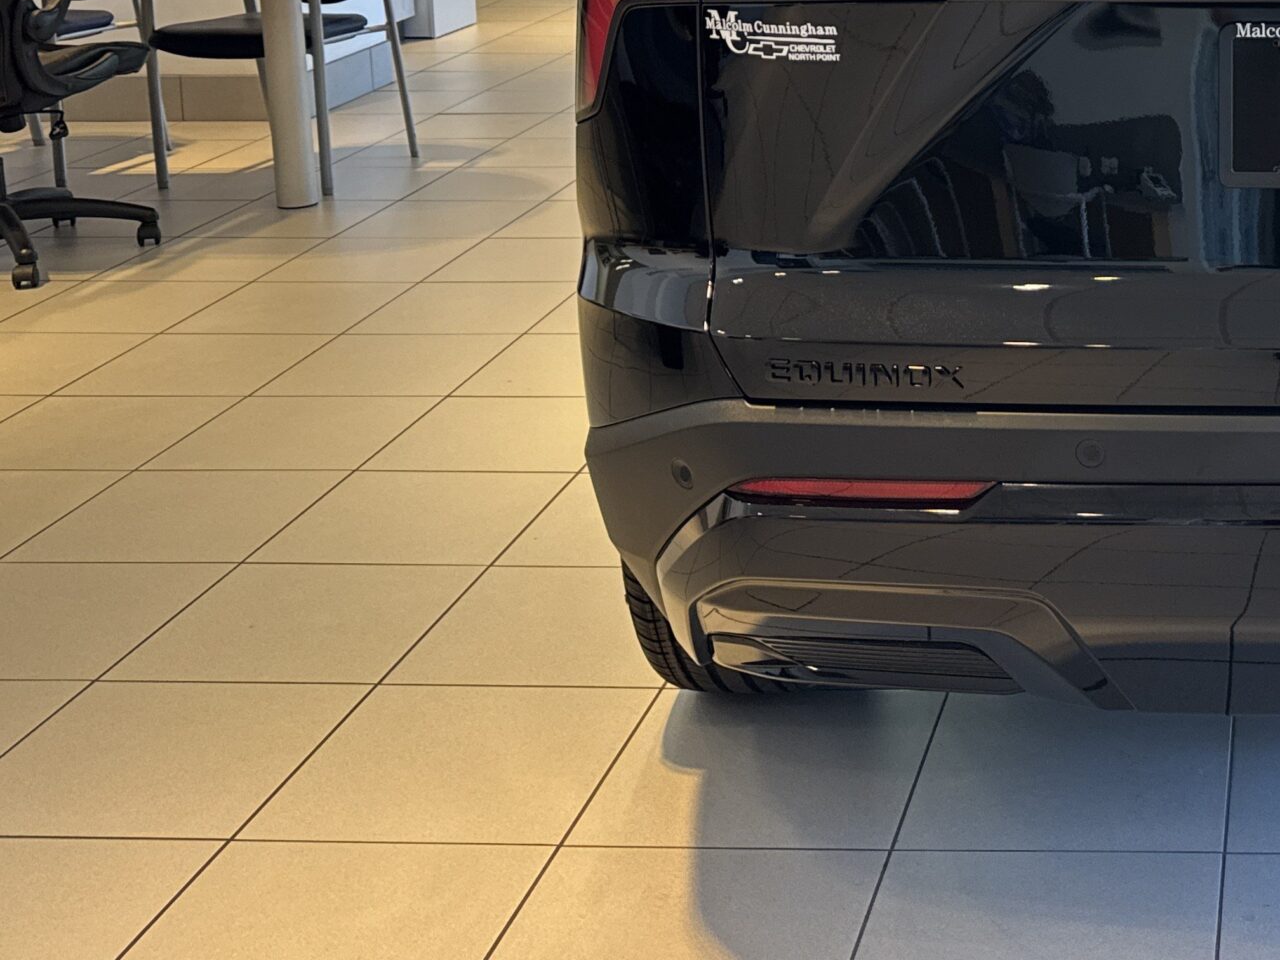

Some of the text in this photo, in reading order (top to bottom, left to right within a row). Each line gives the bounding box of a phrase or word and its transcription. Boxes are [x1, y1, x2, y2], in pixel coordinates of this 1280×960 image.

[705, 16, 838, 38] Malcolm Cunningham
[788, 44, 836, 53] CHEVROLET
[788, 53, 841, 61] NORTH POINT
[766, 357, 965, 390] EQUINOX
